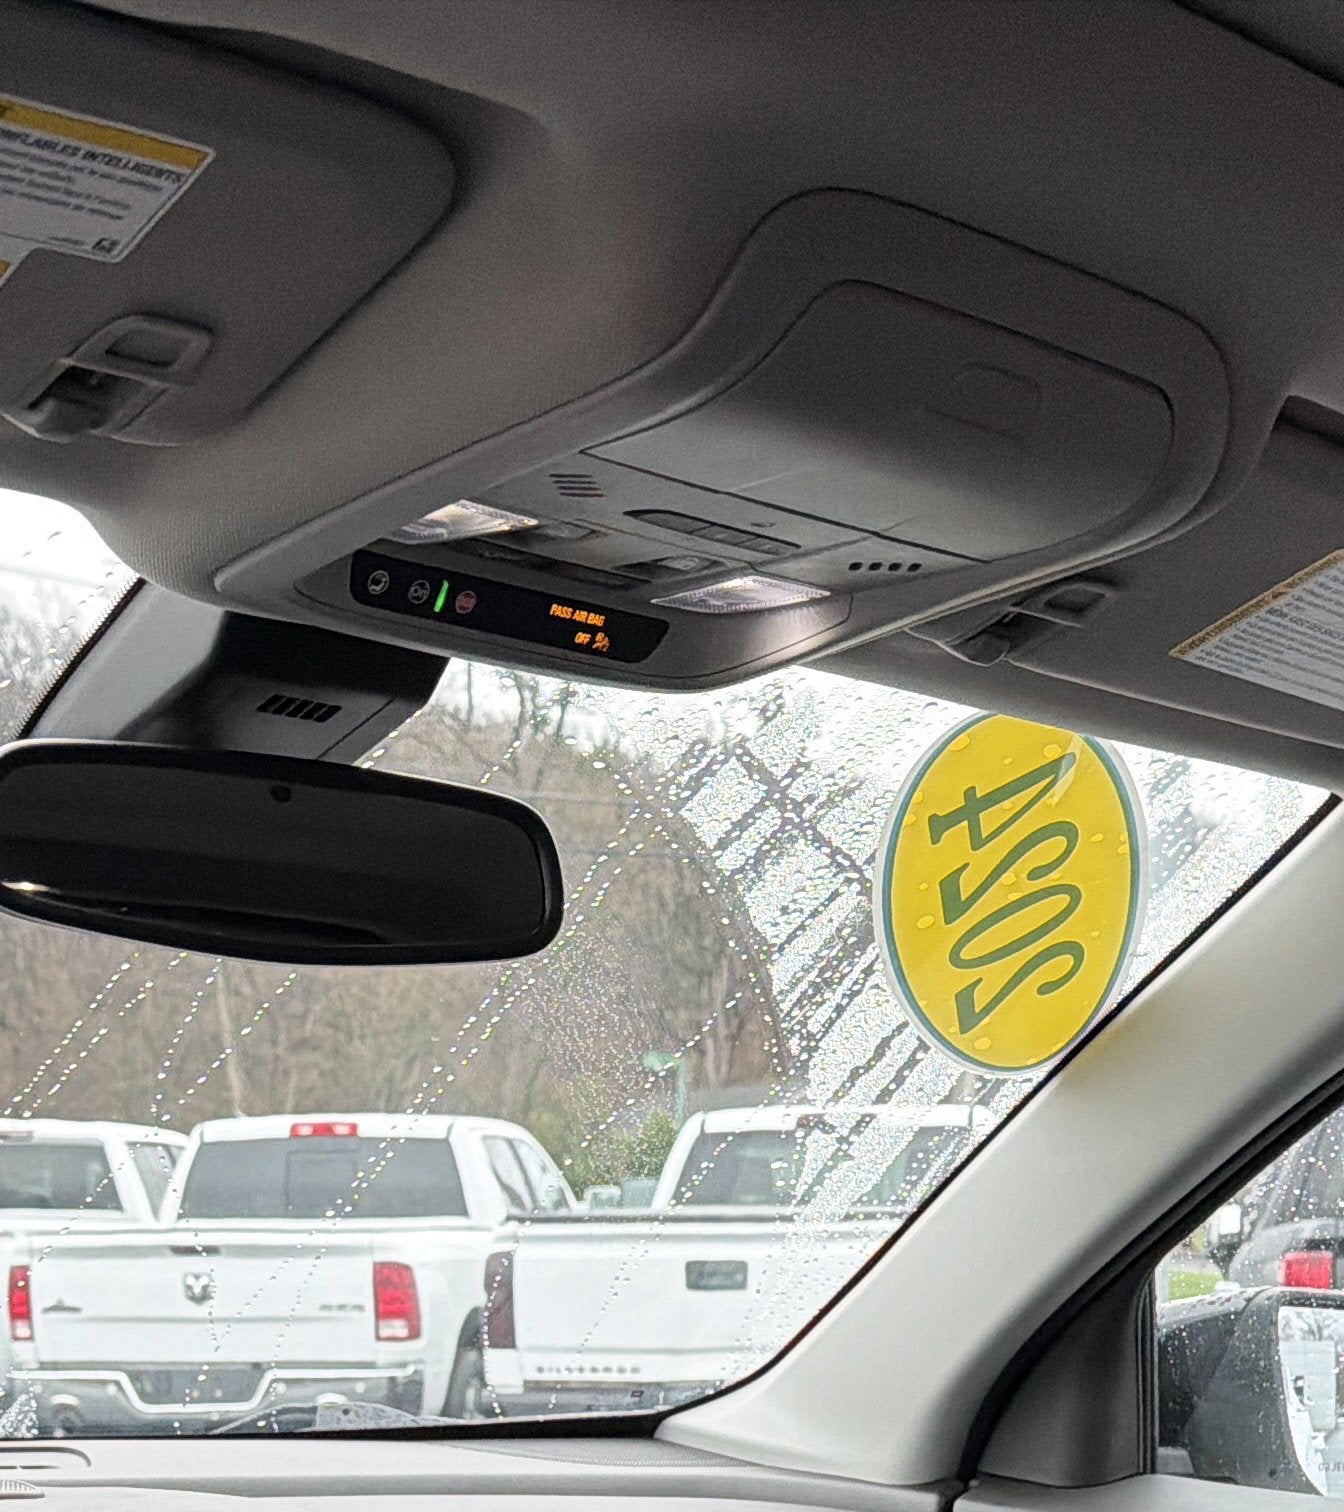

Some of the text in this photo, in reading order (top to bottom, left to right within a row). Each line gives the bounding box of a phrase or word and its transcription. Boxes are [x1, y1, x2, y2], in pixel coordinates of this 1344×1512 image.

[549, 604, 573, 620] PASS
[588, 613, 606, 627] BAG
[574, 632, 592, 646] OFF
